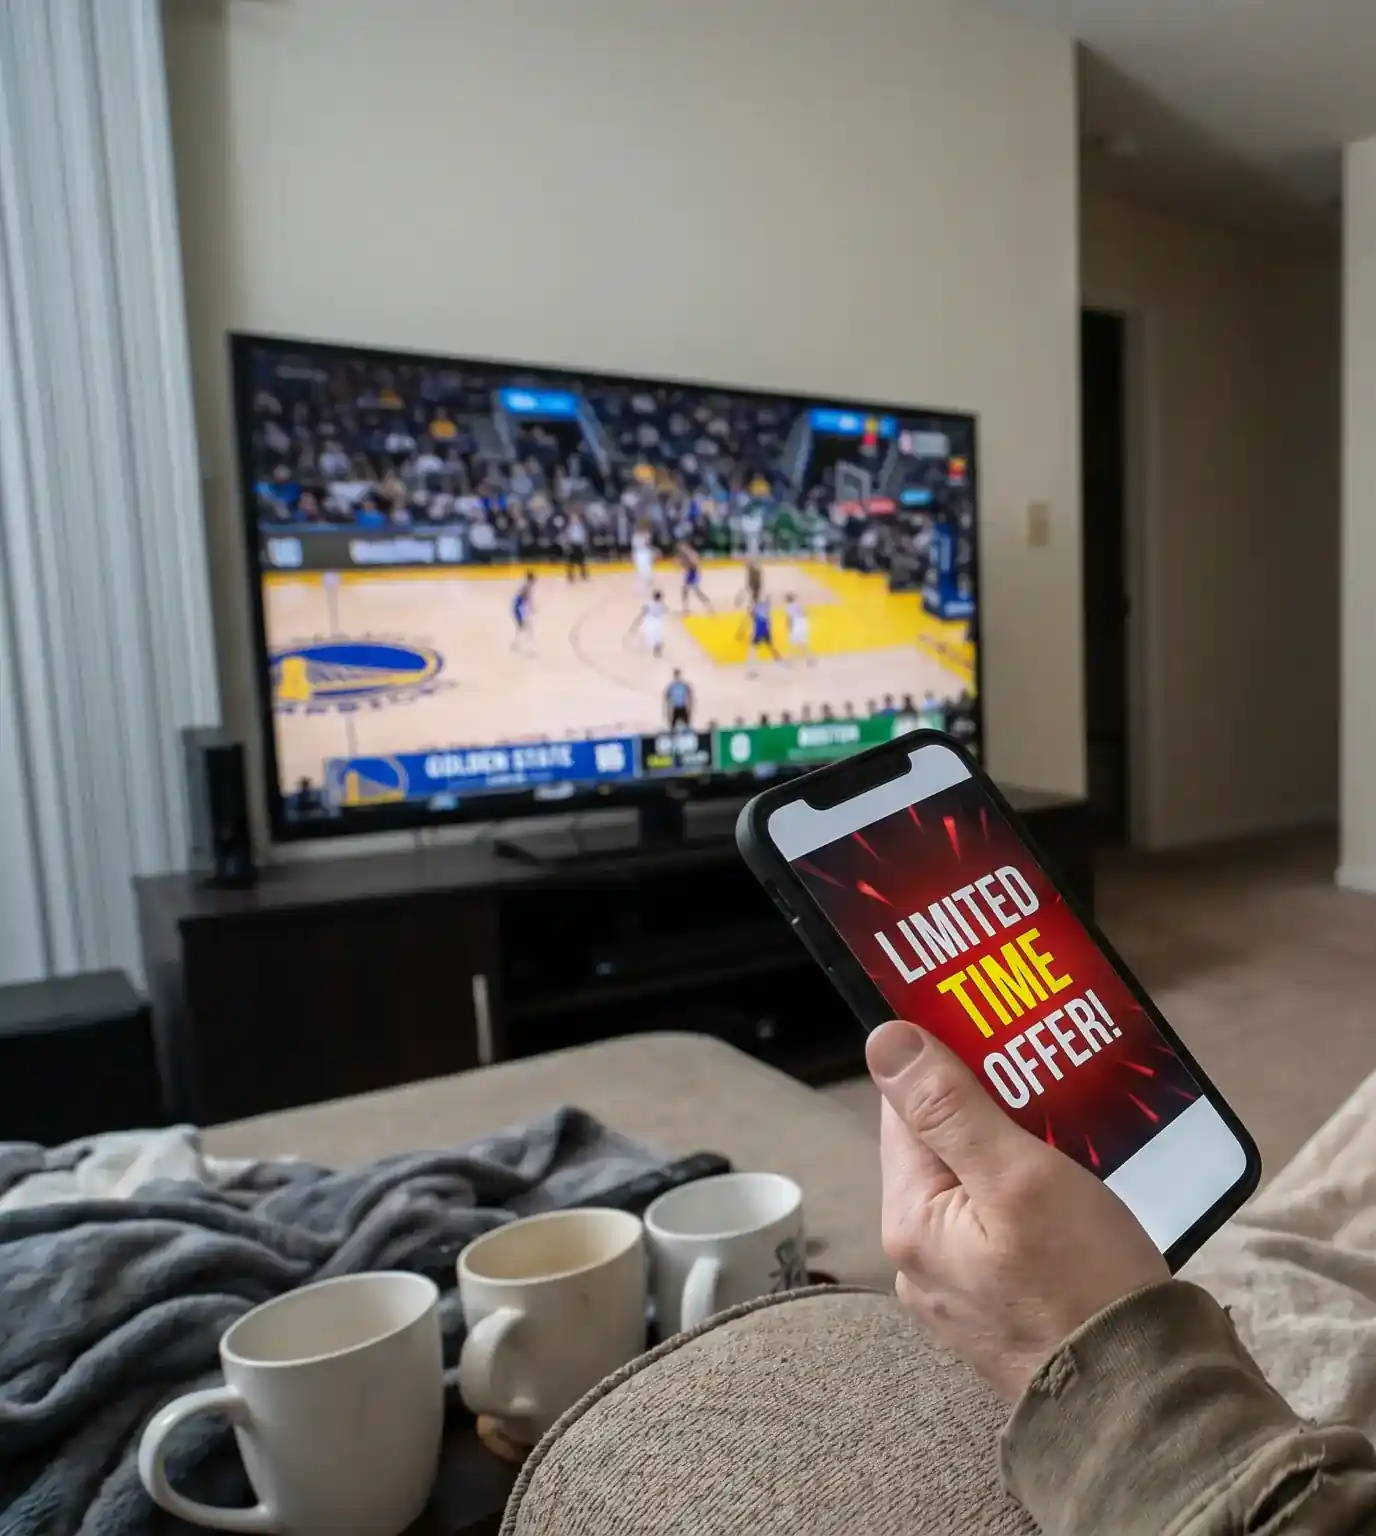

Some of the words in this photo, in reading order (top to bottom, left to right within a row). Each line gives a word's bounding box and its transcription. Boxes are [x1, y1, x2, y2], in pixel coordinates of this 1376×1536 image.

[875, 866, 1039, 983] LIMITED
[937, 928, 1073, 1038] TIME
[984, 988, 1122, 1109] OFFER!
